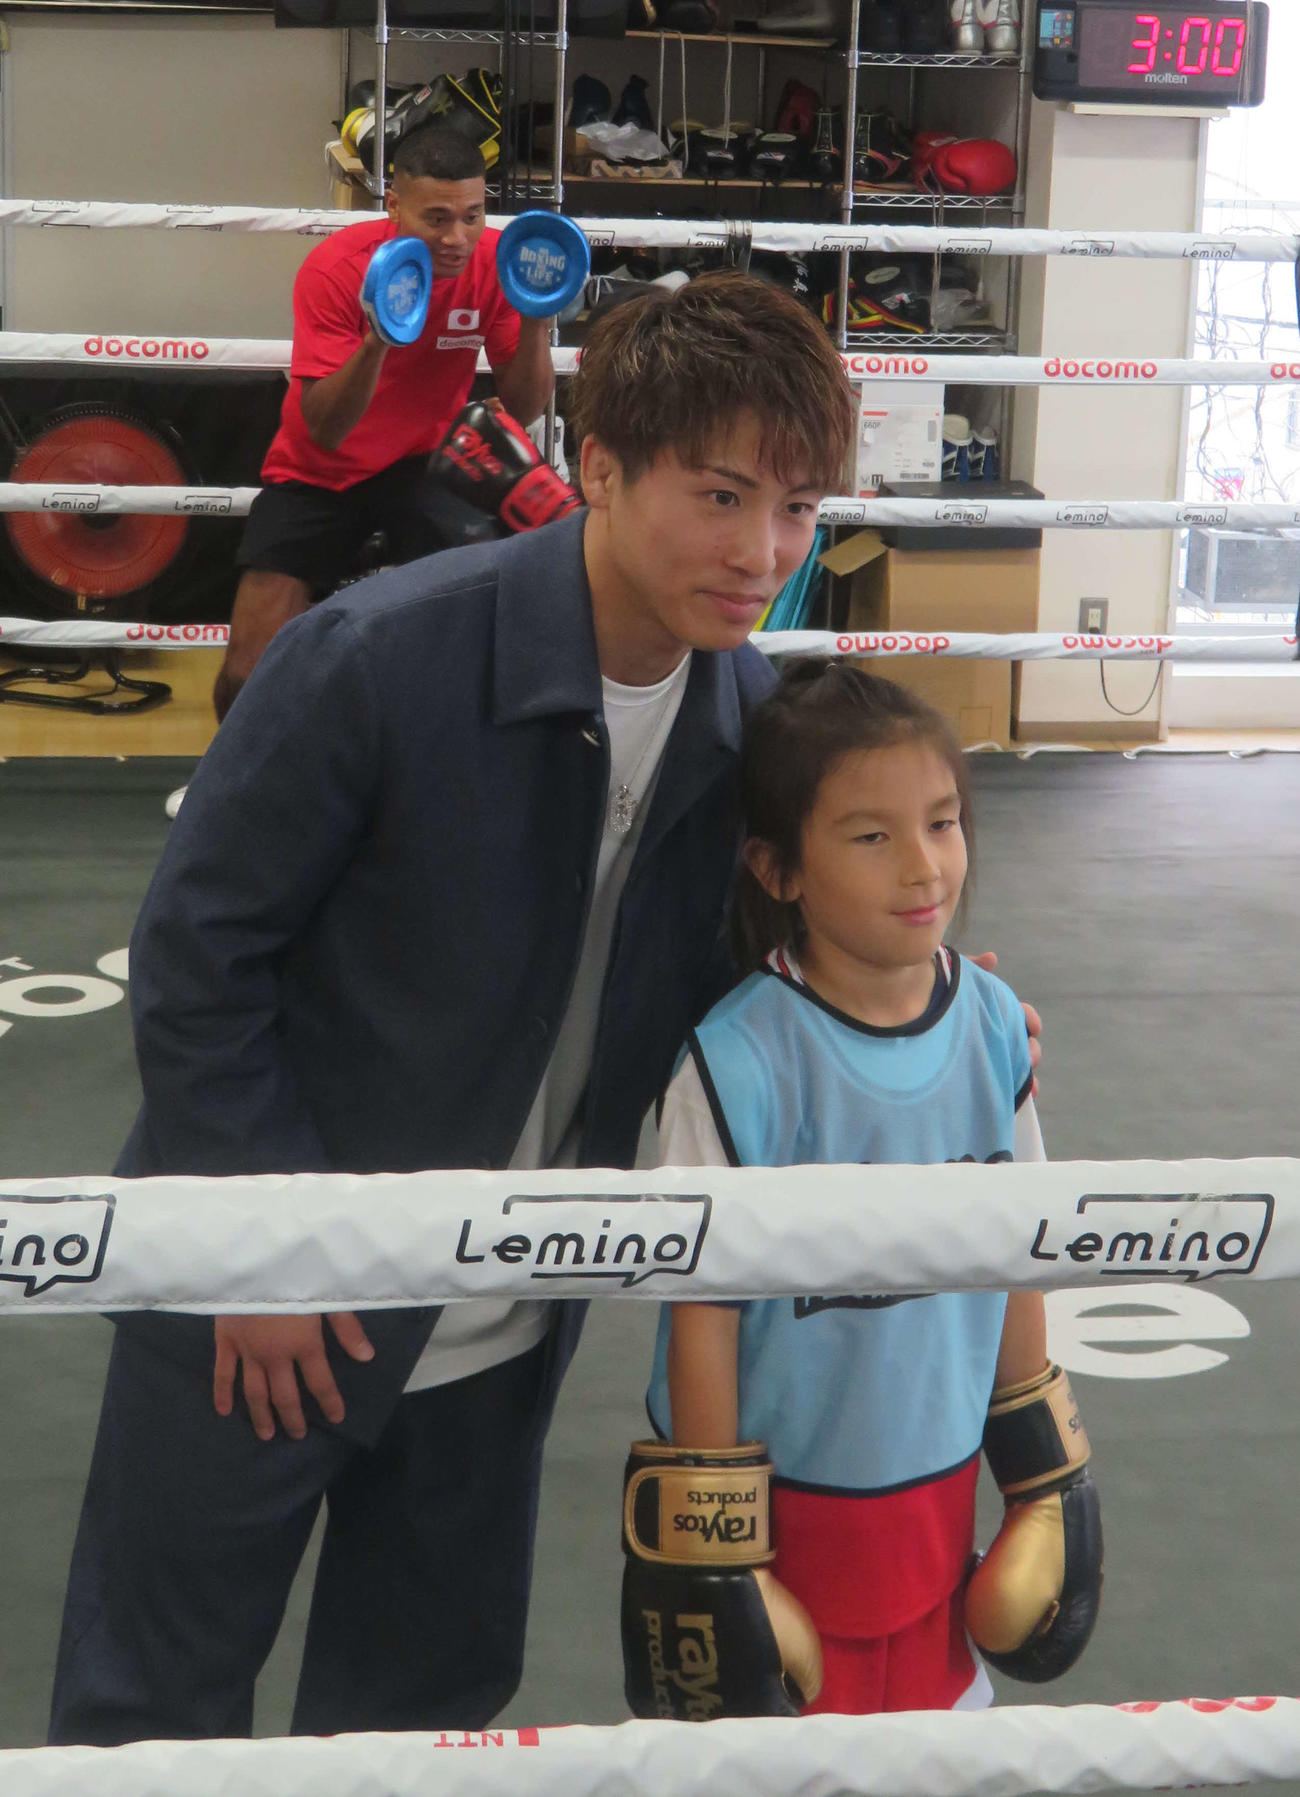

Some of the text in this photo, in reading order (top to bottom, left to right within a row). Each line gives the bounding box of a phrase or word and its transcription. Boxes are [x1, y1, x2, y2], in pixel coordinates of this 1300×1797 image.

[1127, 14, 1246, 76] 3:00
[1144, 72, 1188, 85] molten
[588, 235, 610, 247] ino
[687, 237, 730, 248] Lemin
[812, 240, 866, 251] Lemino
[1182, 247, 1232, 259] Lemino
[84, 335, 209, 360] docomo
[841, 354, 929, 375] como
[1044, 357, 1158, 379] docomo
[42, 497, 96, 511] Lemino
[175, 501, 228, 513] Lemino
[819, 508, 861, 521] emino
[935, 510, 983, 521] Lemino
[1056, 511, 1104, 522] Lemino
[1176, 511, 1222, 523] Lemino
[126, 623, 230, 641] docom
[836, 635, 950, 656] docomo
[0, 1219, 90, 1266] ino
[455, 1218, 689, 1264] Lemino
[1029, 1217, 1251, 1263] Lemino
[687, 1487, 757, 1514] products
[673, 1511, 757, 1544] raytos
[433, 1732, 504, 1748] NTT
